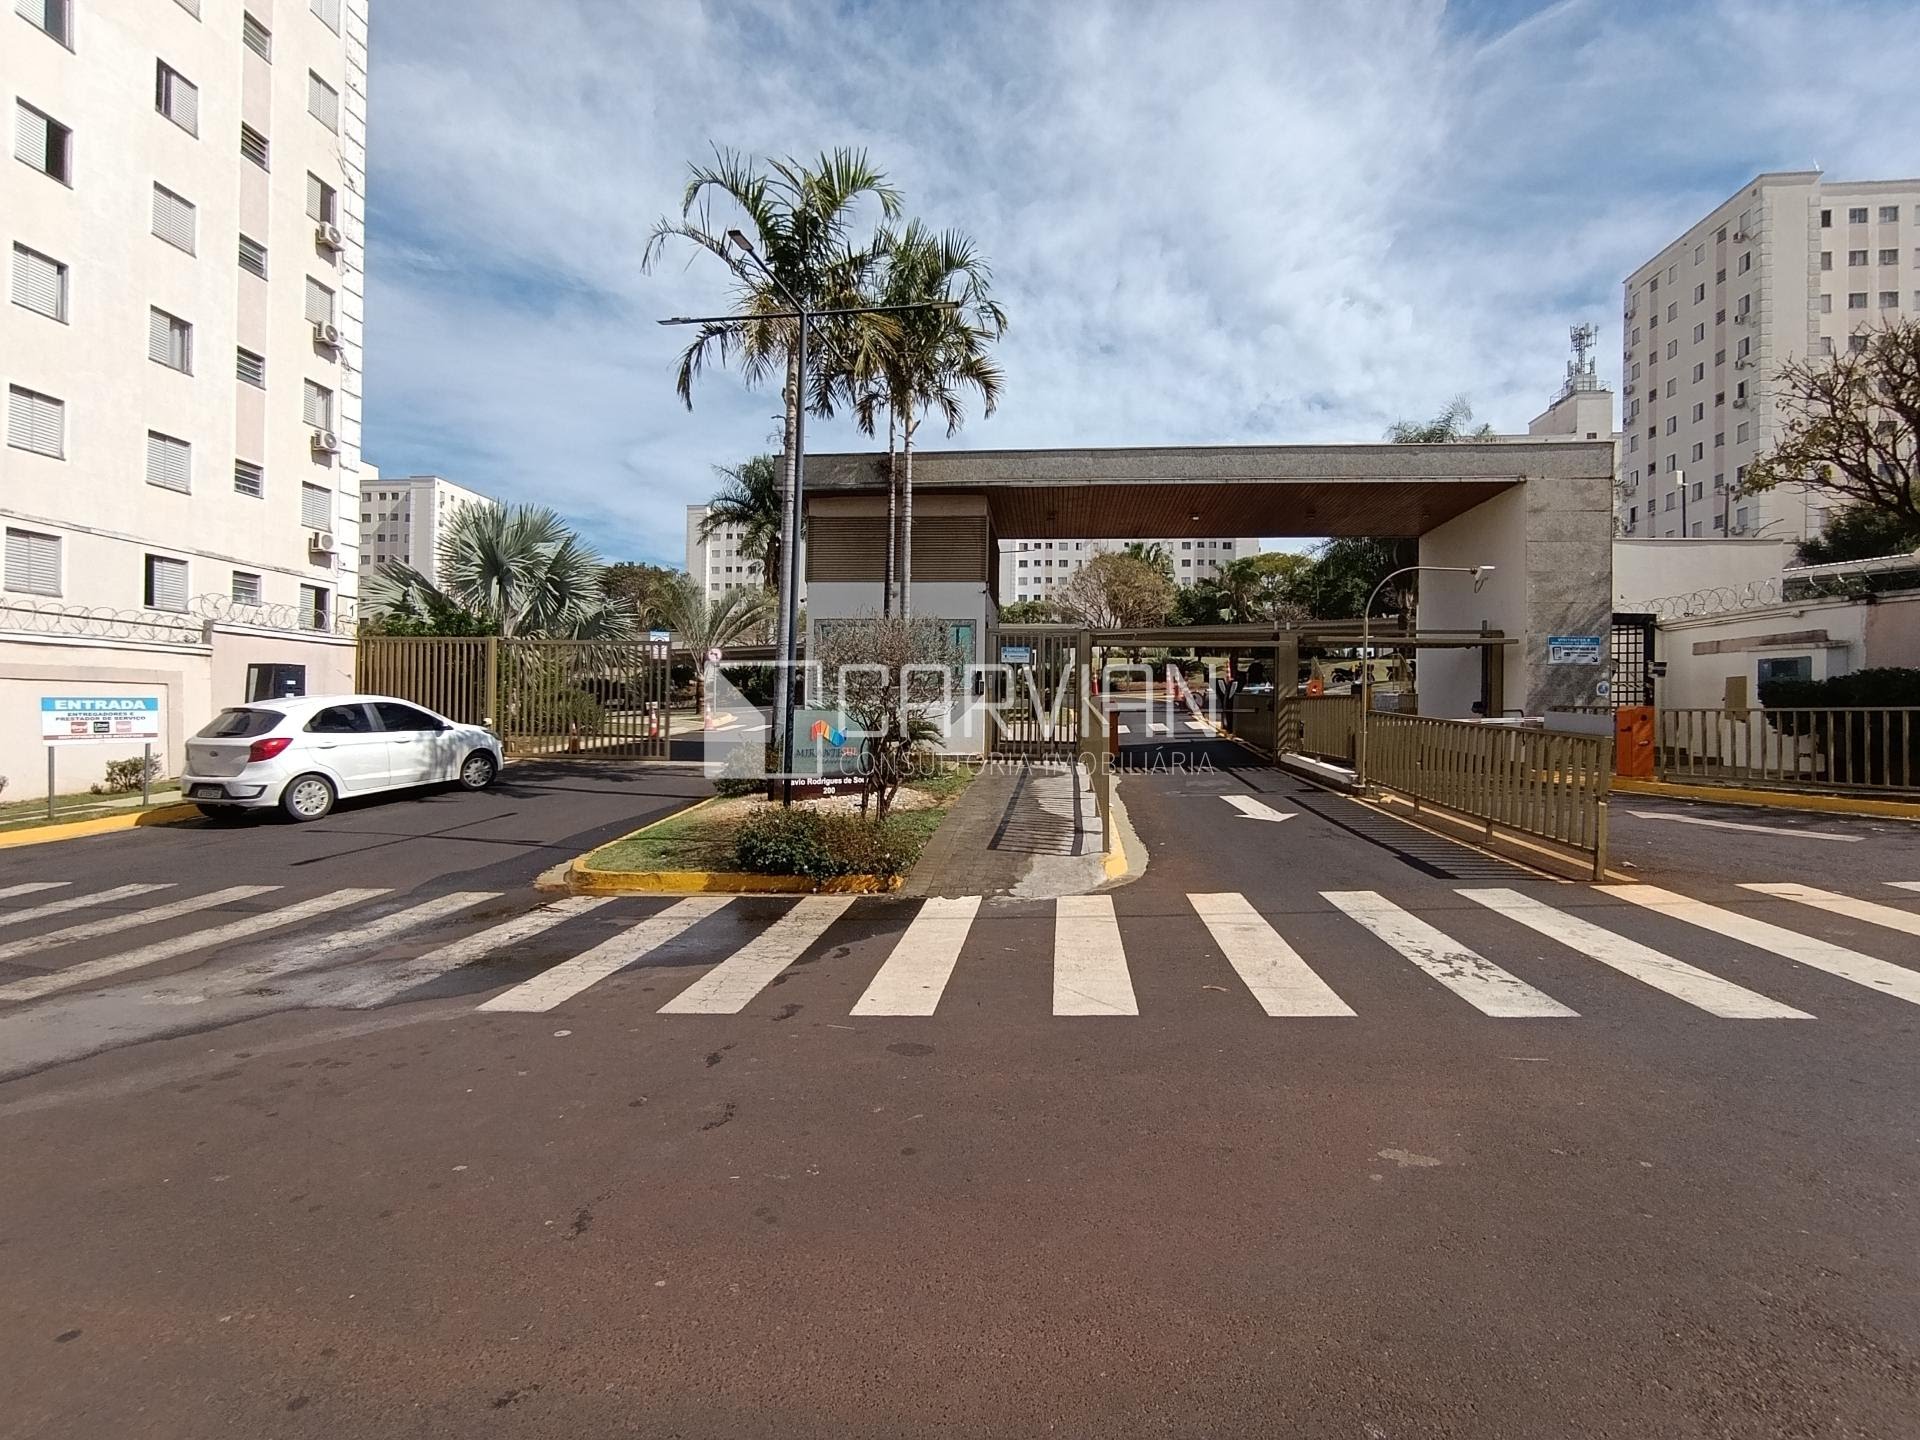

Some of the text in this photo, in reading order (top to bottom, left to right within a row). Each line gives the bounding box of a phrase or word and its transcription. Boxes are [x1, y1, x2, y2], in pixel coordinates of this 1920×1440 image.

[54, 699, 147, 710] ENTRADA
[807, 777, 842, 786] Rodrigues
[822, 786, 836, 795] 200
